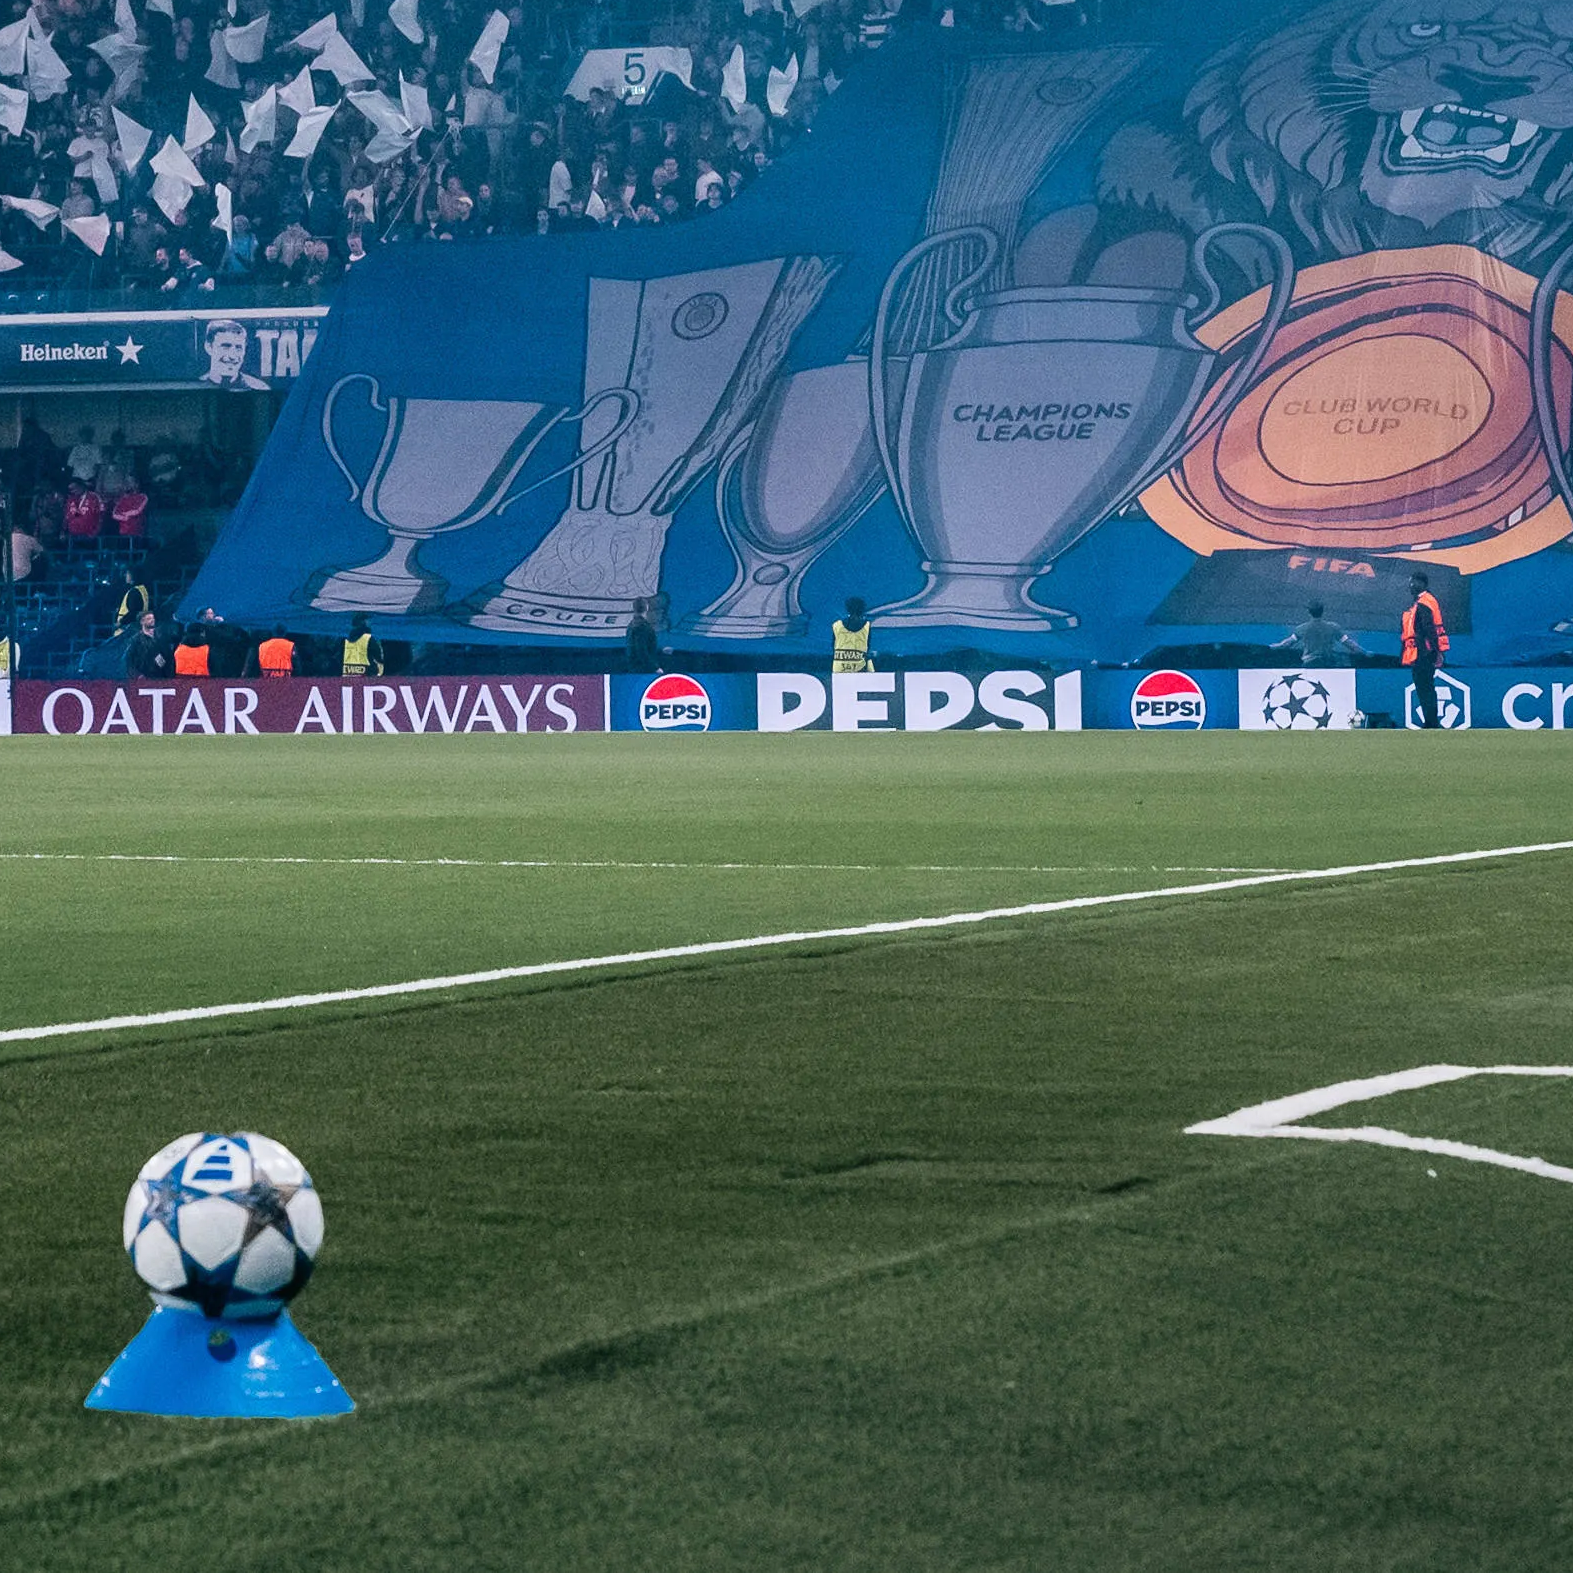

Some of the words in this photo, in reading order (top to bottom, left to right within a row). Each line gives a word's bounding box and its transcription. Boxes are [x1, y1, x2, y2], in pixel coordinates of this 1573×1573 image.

[624, 52, 646, 85] 5
[20, 342, 108, 363] Heineken
[953, 401, 1131, 423] CHAMPIONS
[1283, 397, 1358, 417] CLUB
[1362, 395, 1469, 421] WORLD
[976, 422, 1096, 441] LEAGUE
[1332, 417, 1402, 437] CUP
[1287, 554, 1376, 578] FIFA
[506, 603, 619, 625] COUPE
[41, 688, 259, 735] QATAR
[294, 683, 578, 734] AIRWAYS
[756, 670, 1083, 732] PEPSI
[1135, 700, 1203, 719] PEPSI
[643, 703, 709, 723] PEPSI
